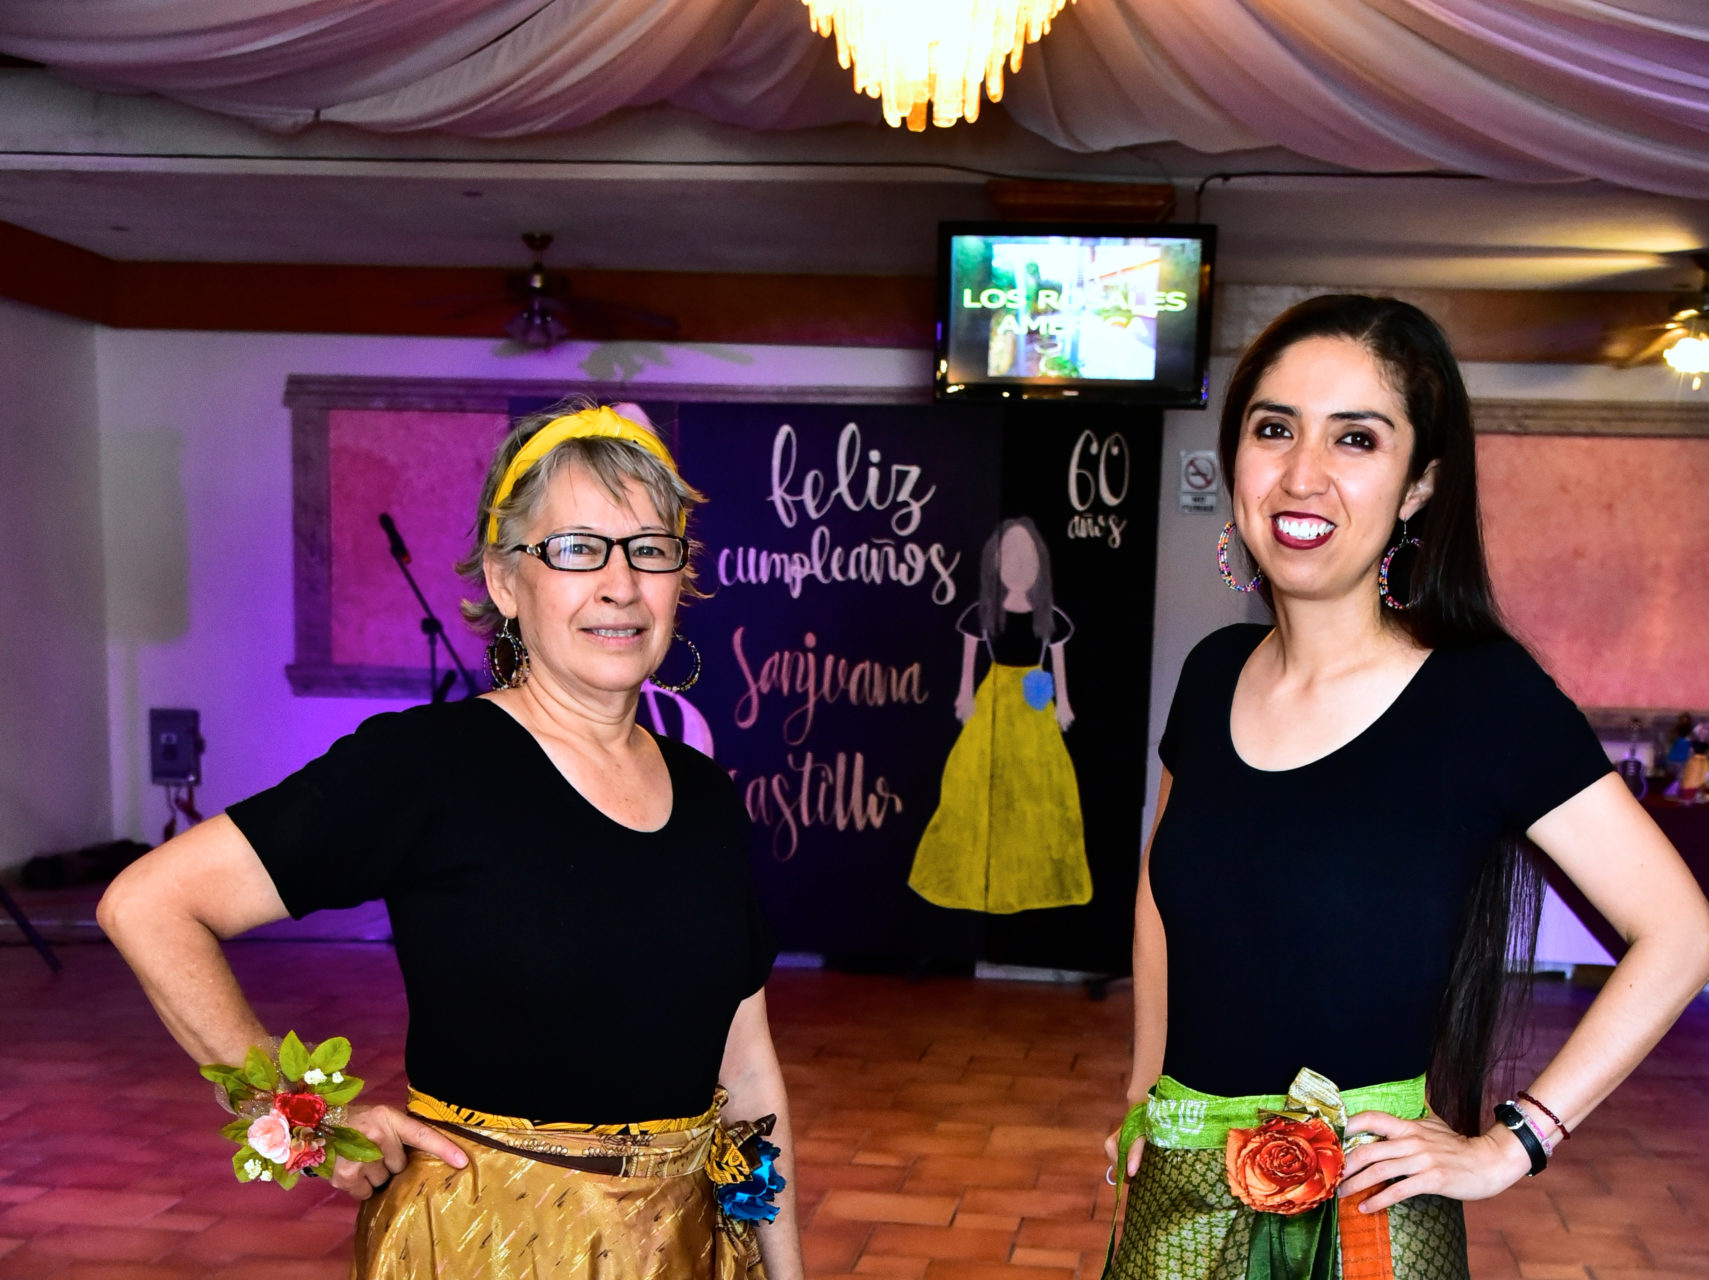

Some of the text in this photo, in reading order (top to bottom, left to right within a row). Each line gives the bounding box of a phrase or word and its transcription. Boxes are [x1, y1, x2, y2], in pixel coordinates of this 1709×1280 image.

[963, 288, 1188, 312] LOS ROSALES
[997, 314, 1149, 336] AMECA
[767, 422, 937, 537] feliz
[1067, 429, 1130, 511] 60
[718, 525, 962, 605] cumpleaños
[1067, 513, 1127, 548] años
[729, 751, 903, 862] astillo
